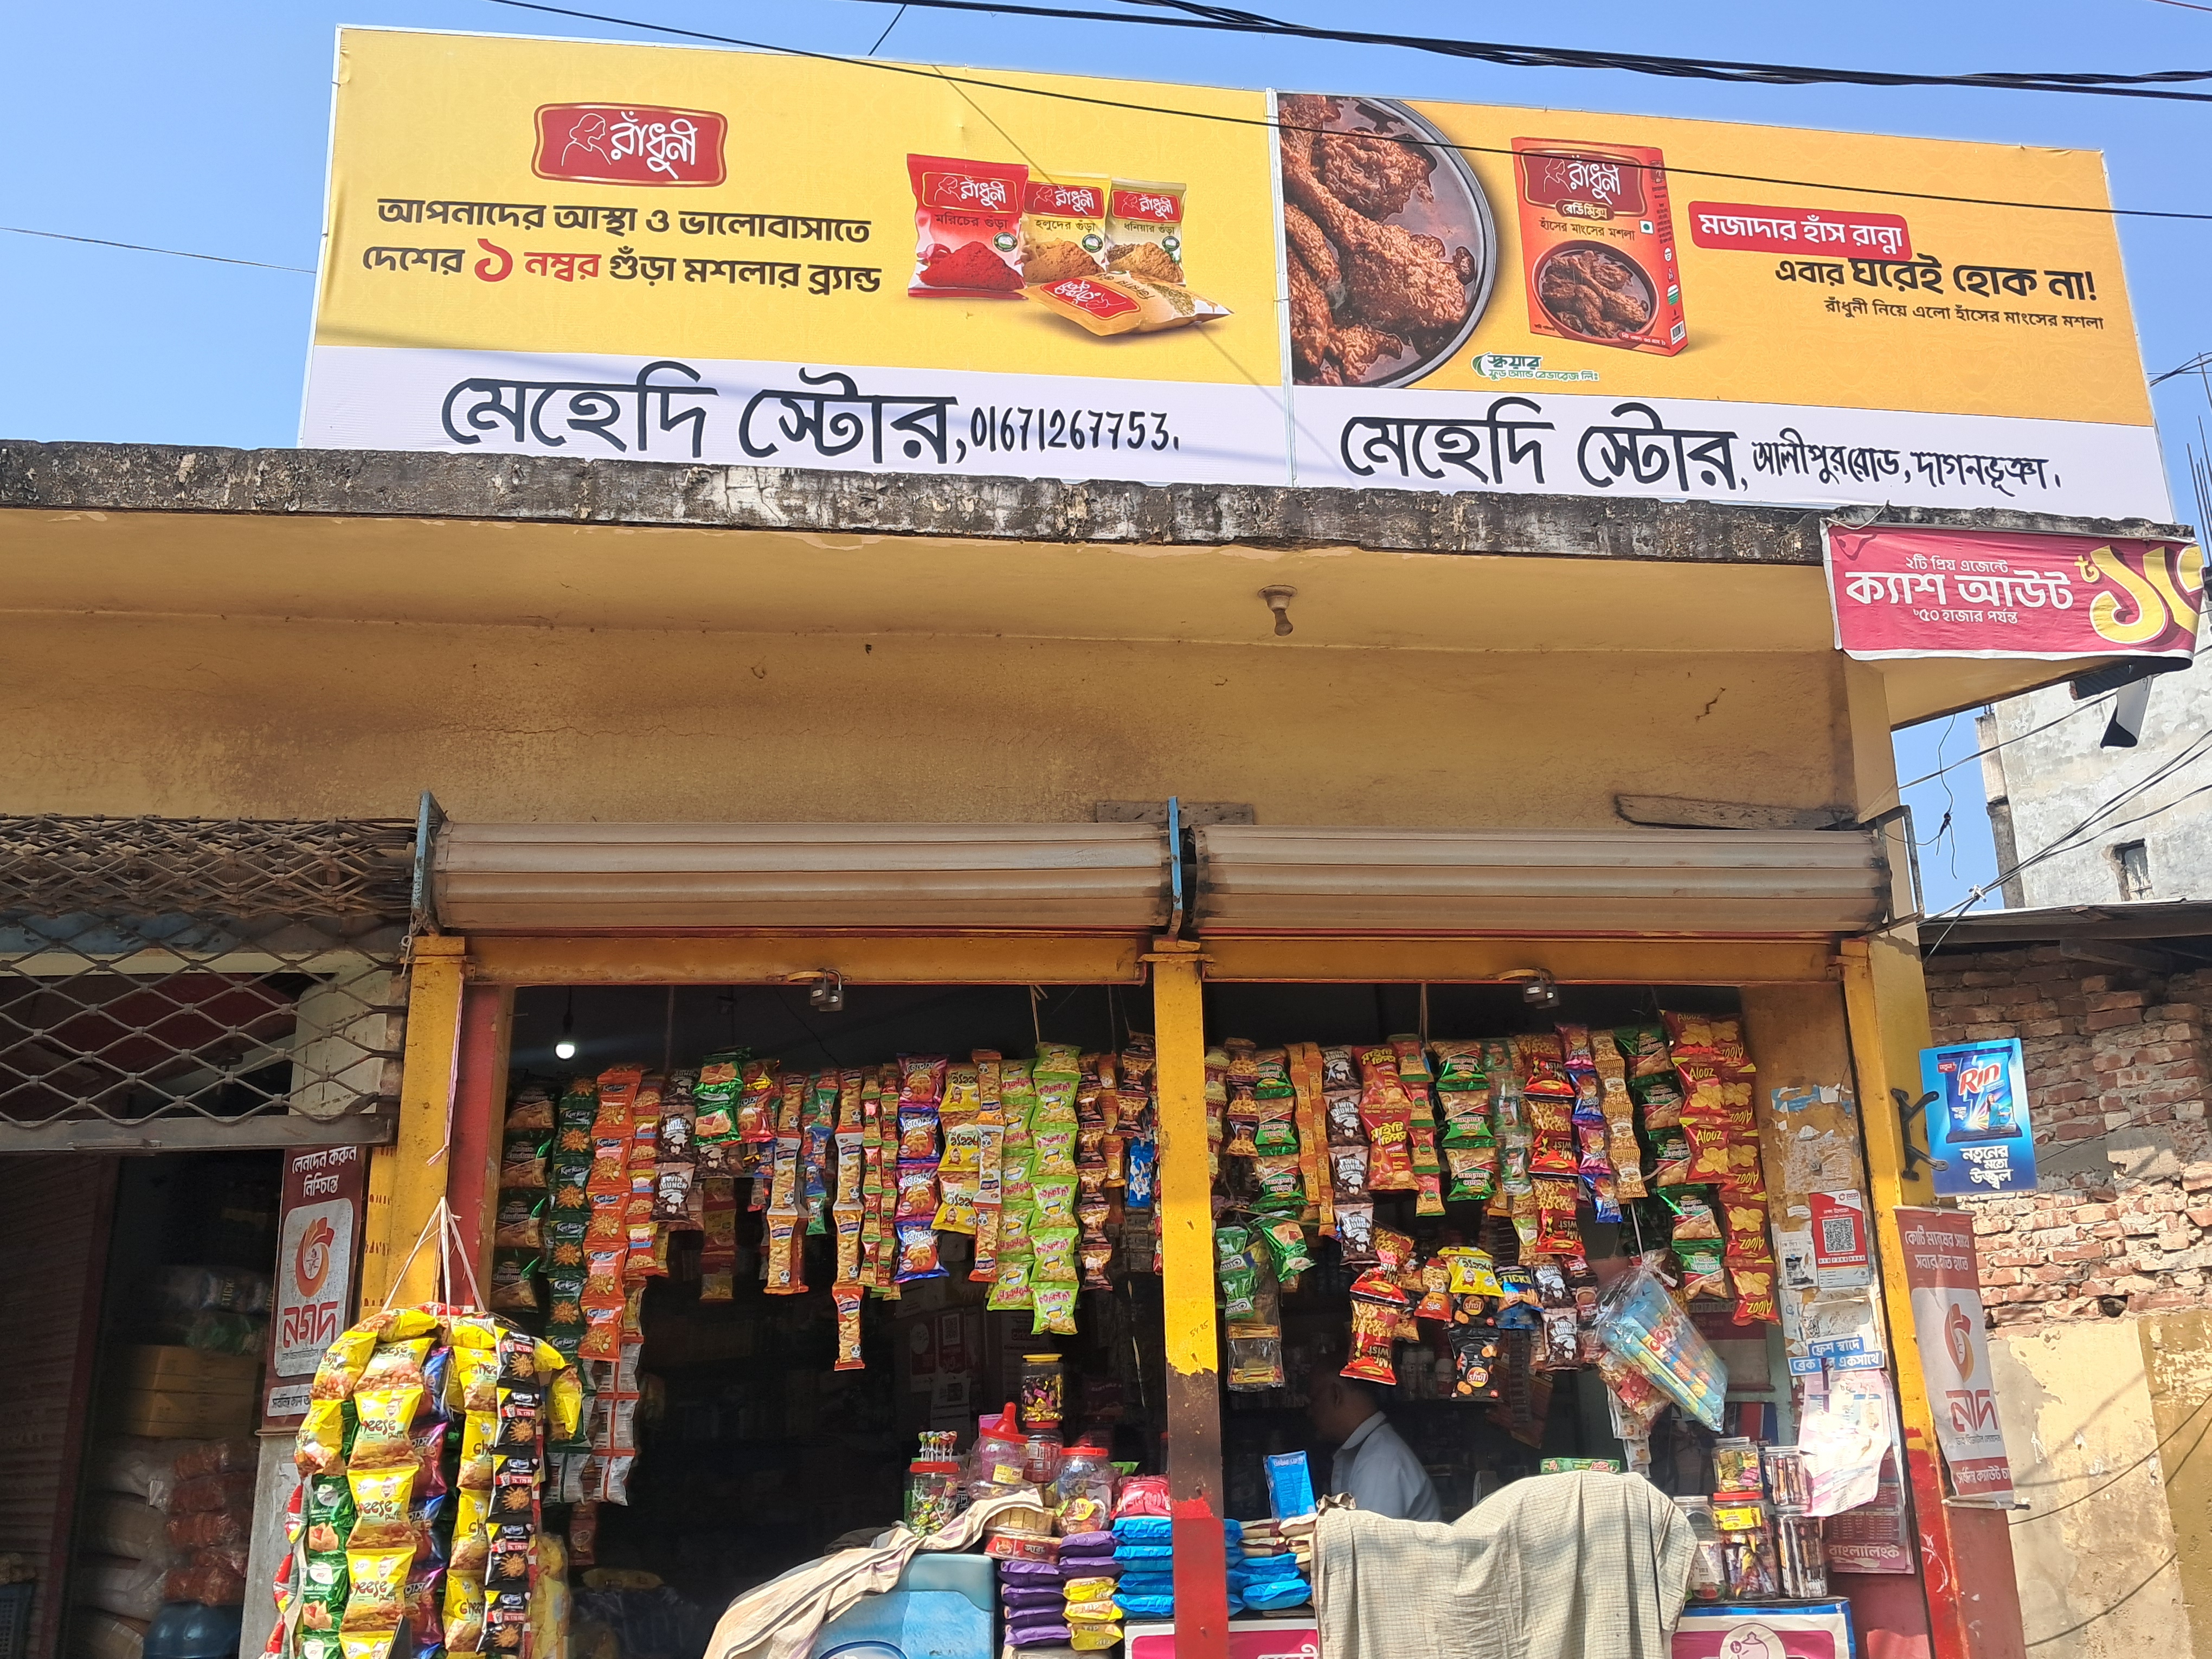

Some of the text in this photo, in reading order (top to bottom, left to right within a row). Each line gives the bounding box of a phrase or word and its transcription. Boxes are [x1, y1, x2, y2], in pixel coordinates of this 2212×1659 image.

[609, 112, 698, 179] রাঁধুনী
[1567, 155, 1621, 204] রাঁধুনী
[959, 176, 1007, 210] রাঁধুনী
[1055, 184, 1094, 214] রাঁধুনী
[1140, 192, 1174, 219] রাঁধুনী
[1562, 202, 1607, 218] রেডিমিক্স
[377, 198, 871, 243] আপনাদের আস্থা ও ভালোবাসাতে
[935, 214, 979, 227] মরিচের
[1036, 220, 1071, 233] হলুদের
[1539, 217, 1635, 241] হাঁসের মাংসের মশলা
[1699, 214, 1903, 255] মজাদার হাঁস রান্না
[363, 238, 882, 296] দেশের ১ নম্বর গুঁড়া মশলার ব্র্যান্ড
[1775, 254, 2095, 301] এবার ঘরেই হোক না!
[1824, 296, 2105, 330] রাঁধুনী নিয়ে এলো হাঁসের মাংসের মশলা
[1488, 354, 1541, 369] স্কয়ার
[1489, 368, 1508, 381] ফুড
[1535, 370, 1579, 381] বেভারেজ
[442, 361, 721, 458] মেহেদি
[1340, 397, 1555, 485] মেহেদি
[1905, 553, 2008, 574] ২টি প্রিয় এজেন্টে
[1844, 570, 1946, 606] ক্যাশ
[1954, 569, 2074, 609] আউট
[1943, 609, 1982, 623] হাজার
[1988, 610, 2018, 625] পর্যন্ত
[1958, 1063, 2001, 1095] Rin
[950, 1134, 979, 1149] heese
[1553, 1141, 1572, 1149] wist
[292, 1146, 357, 1174] লেনদেন করুন
[1960, 1146, 2009, 1164] নতুনের
[1983, 1159, 2008, 1169] মতো
[303, 1172, 339, 1198] নিশ্চিন্তে
[1970, 1168, 2013, 1189] উজ্জ্বল
[1558, 1220, 1577, 1230] wist
[1905, 1224, 1926, 1246] কোটি
[1380, 1263, 1398, 1272] wist
[1462, 1260, 1492, 1273] heese
[1914, 1254, 1939, 1270] সবার
[283, 1301, 338, 1348] নগদ
[1811, 1339, 1860, 1356] ফ্রেশ স্বাদে
[471, 1361, 497, 1373] Chee
[1838, 1353, 1880, 1367] একসাথে
[1468, 1372, 1487, 1383] Lay's
[1945, 1389, 1998, 1433] নদ
[361, 1417, 396, 1435] heese
[473, 1440, 492, 1456] Che
[1829, 1542, 1900, 1560] বাংলালিংক
[350, 1579, 387, 1596] heese
